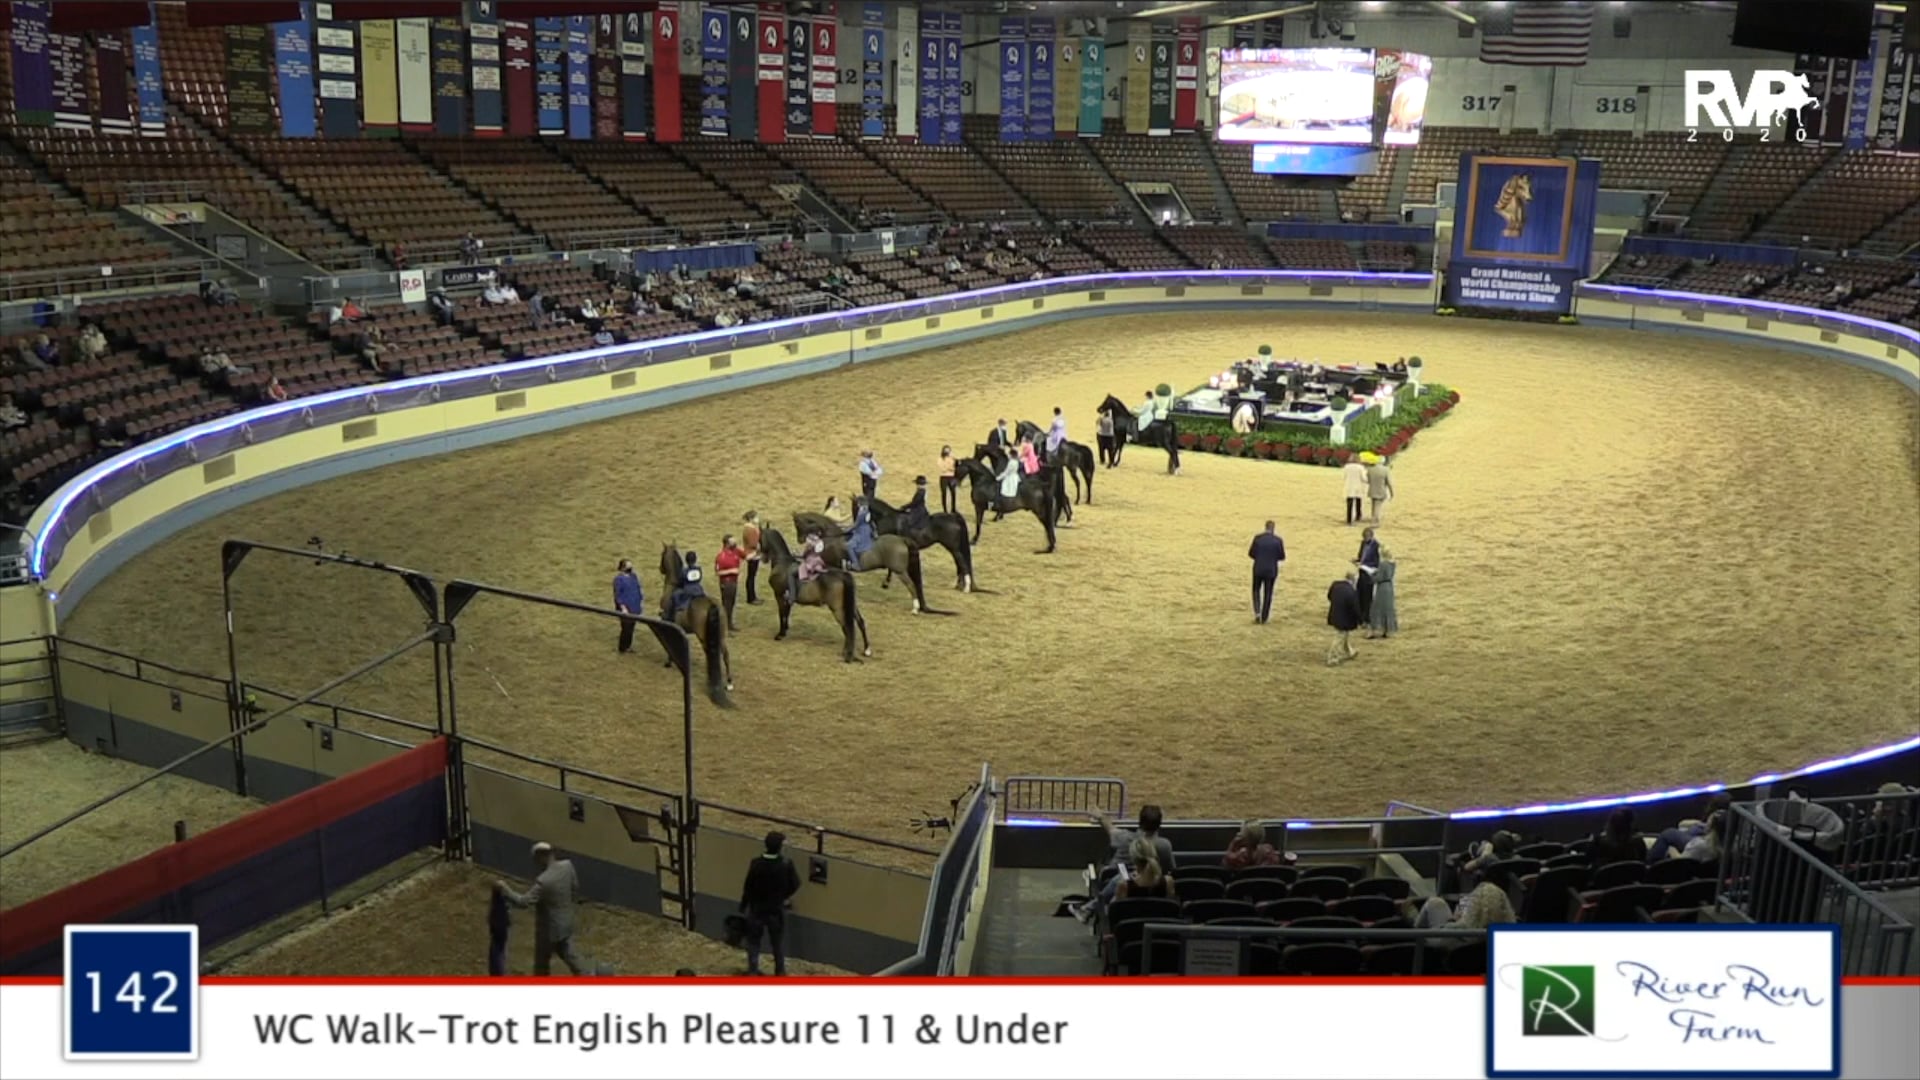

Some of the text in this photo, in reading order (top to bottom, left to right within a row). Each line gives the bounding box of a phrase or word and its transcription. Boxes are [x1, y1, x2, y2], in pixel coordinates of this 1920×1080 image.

[1462, 95, 1500, 111] 317
[1596, 97, 1636, 113] 318
[1471, 267, 1501, 278] Grand
[1502, 269, 1543, 281] National
[1460, 277, 1561, 293] World Championship
[1461, 288, 1498, 300] Morgan
[1499, 290, 1527, 302] Horse
